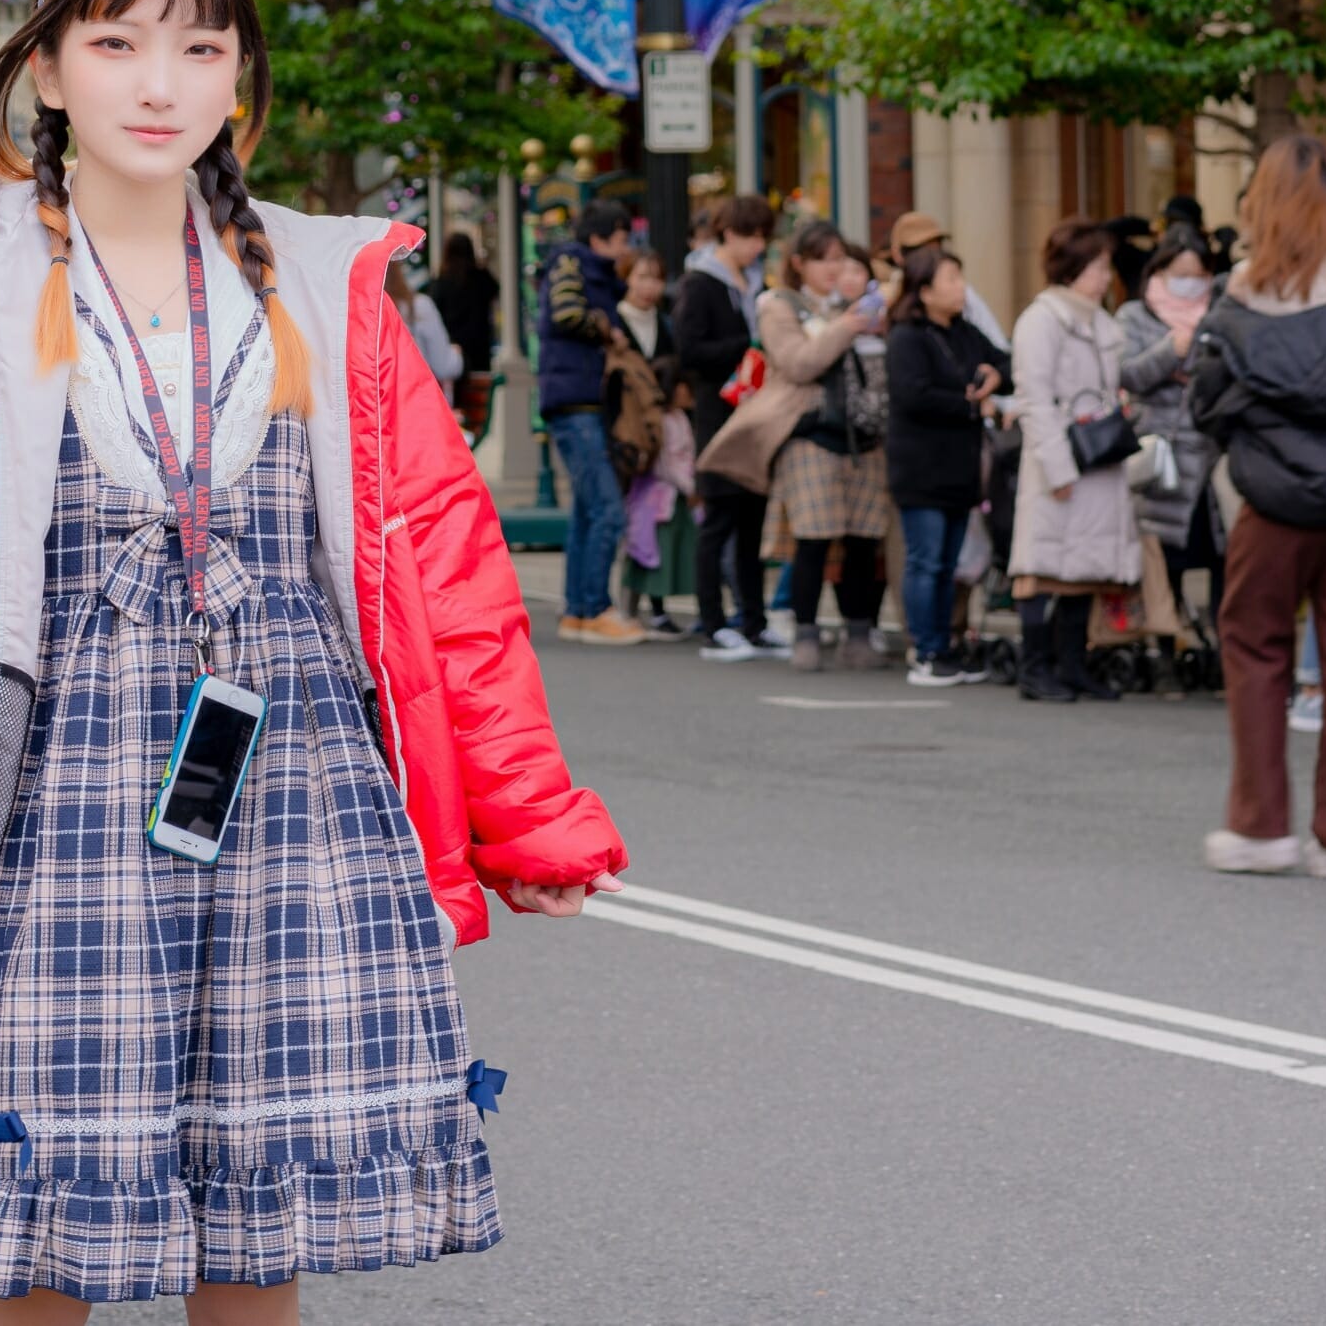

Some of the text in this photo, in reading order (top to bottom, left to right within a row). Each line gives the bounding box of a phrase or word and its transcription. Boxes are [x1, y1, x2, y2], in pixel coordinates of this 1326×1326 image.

[188, 255, 206, 313] UN NERV
[192, 324, 210, 387] UN NERV
[150, 411, 182, 476] UN NERV
[195, 402, 211, 470] UN NERV
[174, 491, 191, 513] UN
[195, 484, 210, 553] UN NERV
